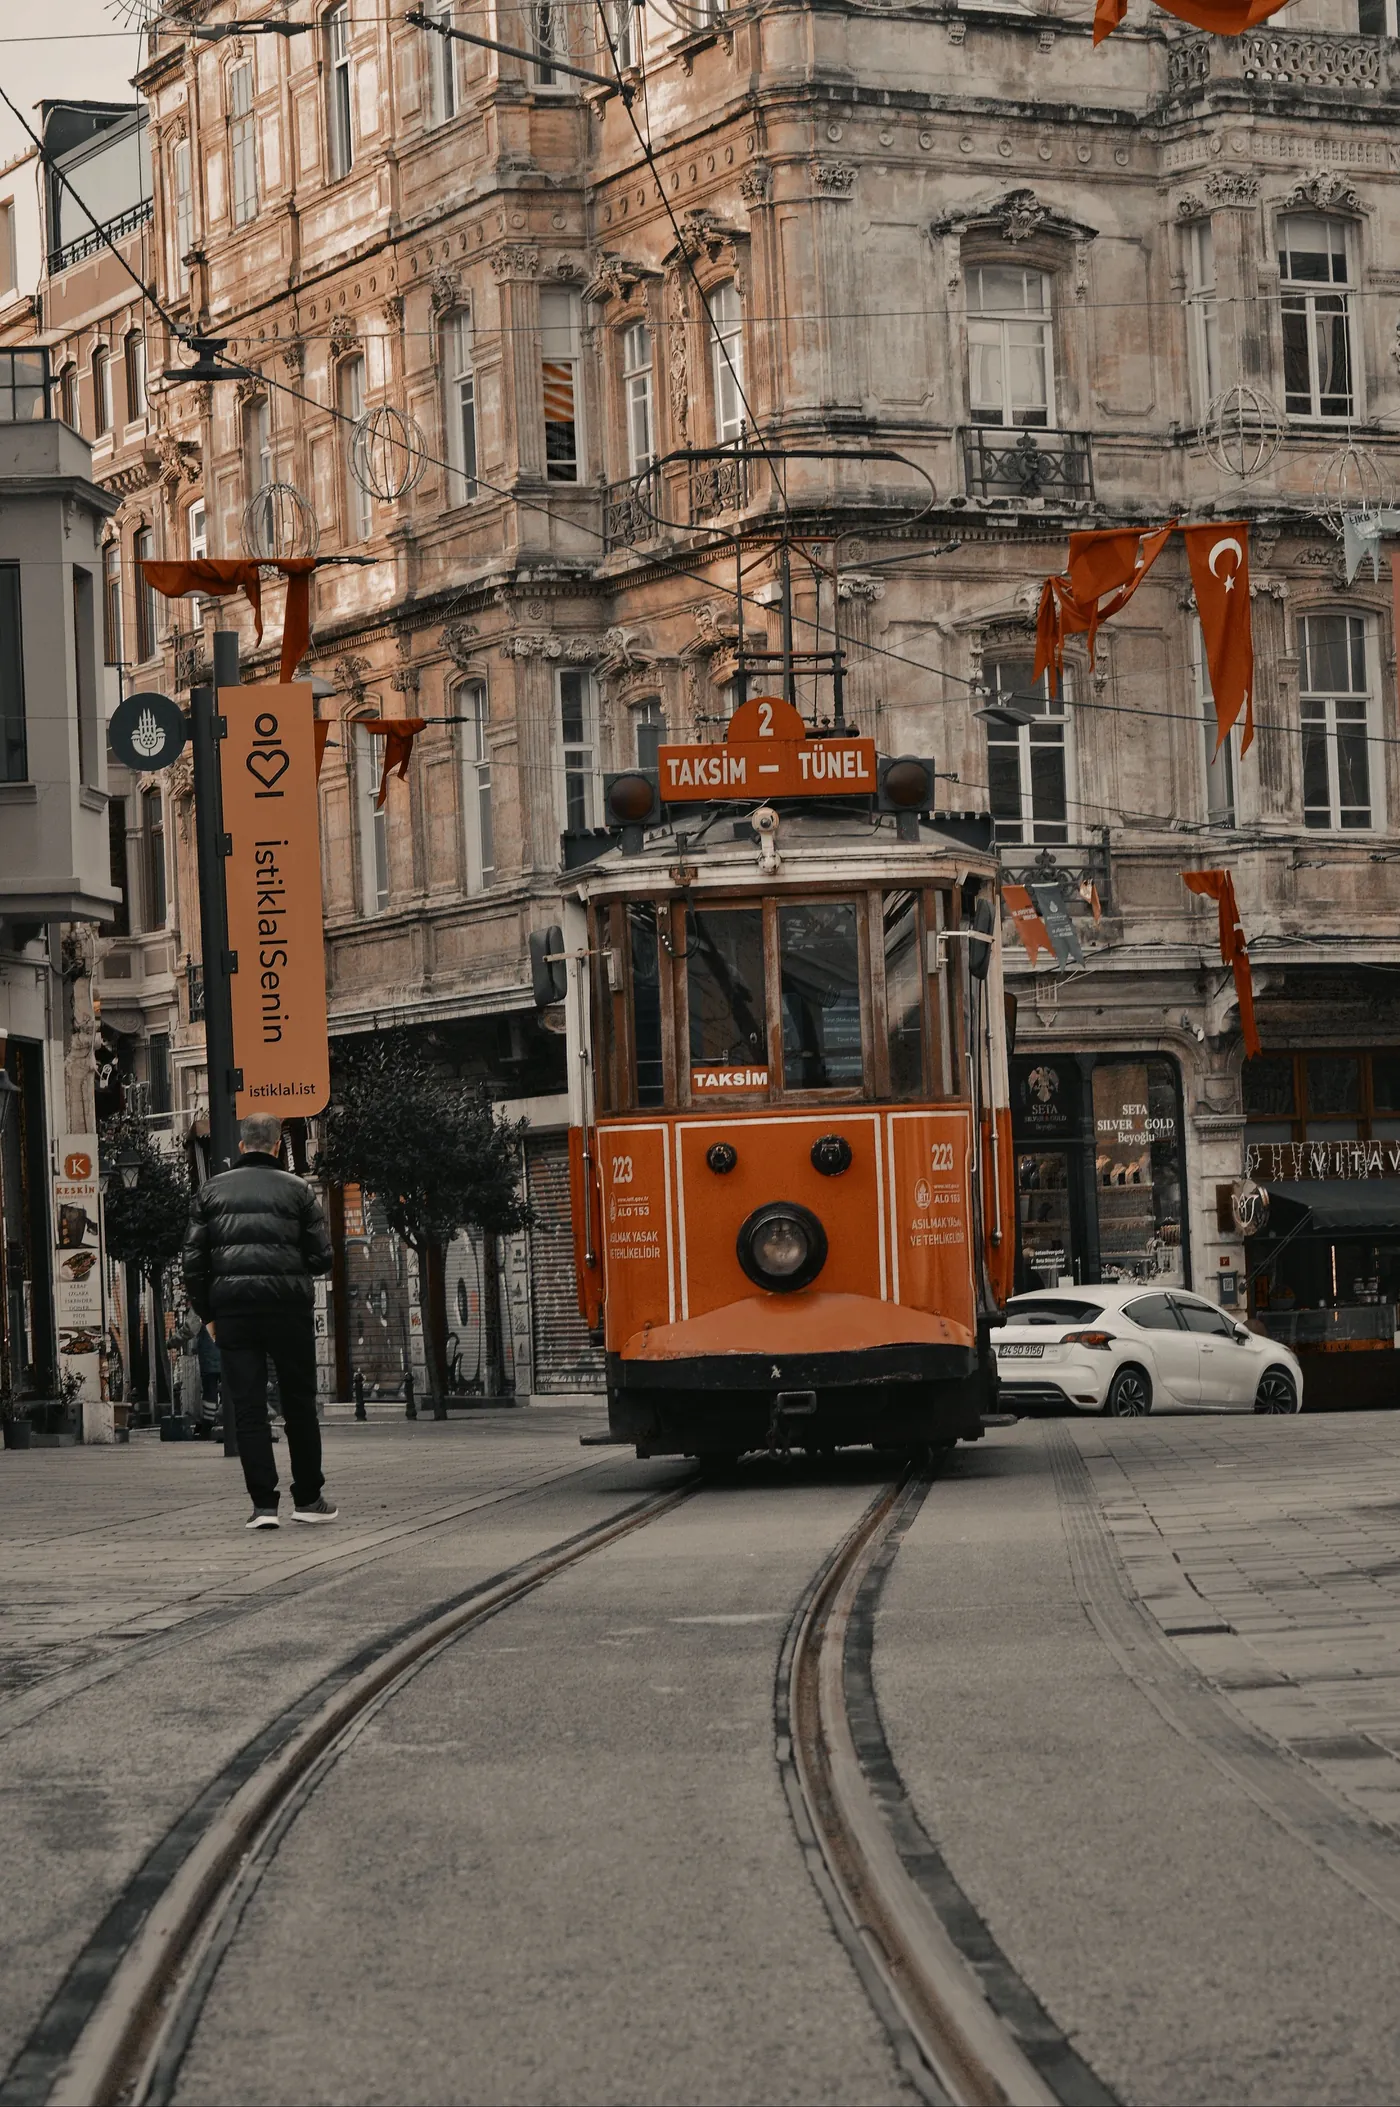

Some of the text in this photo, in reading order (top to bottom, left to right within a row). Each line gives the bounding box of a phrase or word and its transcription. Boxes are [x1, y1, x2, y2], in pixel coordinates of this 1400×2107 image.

[758, 702, 774, 737] 2
[666, 750, 747, 786] TAKSİM
[798, 744, 870, 780] TÜNEL
[693, 1069, 768, 1087] TAKSİM
[249, 1082, 316, 1098] istiklal.ist
[1031, 1103, 1058, 1115] SETA
[1122, 1103, 1148, 1116] SETA
[1097, 1119, 1133, 1131] SILVER
[1144, 1117, 1175, 1130] GOLD
[1117, 1130, 1156, 1146] Beyoğlu
[932, 1142, 954, 1171] 223
[71, 1158, 86, 1175] K
[612, 1155, 633, 1184] 223
[56, 1184, 95, 1195] KESKİN
[633, 1206, 650, 1217] 153
[912, 1217, 947, 1230] ASILMAK
[632, 1230, 658, 1242] YASAK
[910, 1235, 921, 1247] VE
